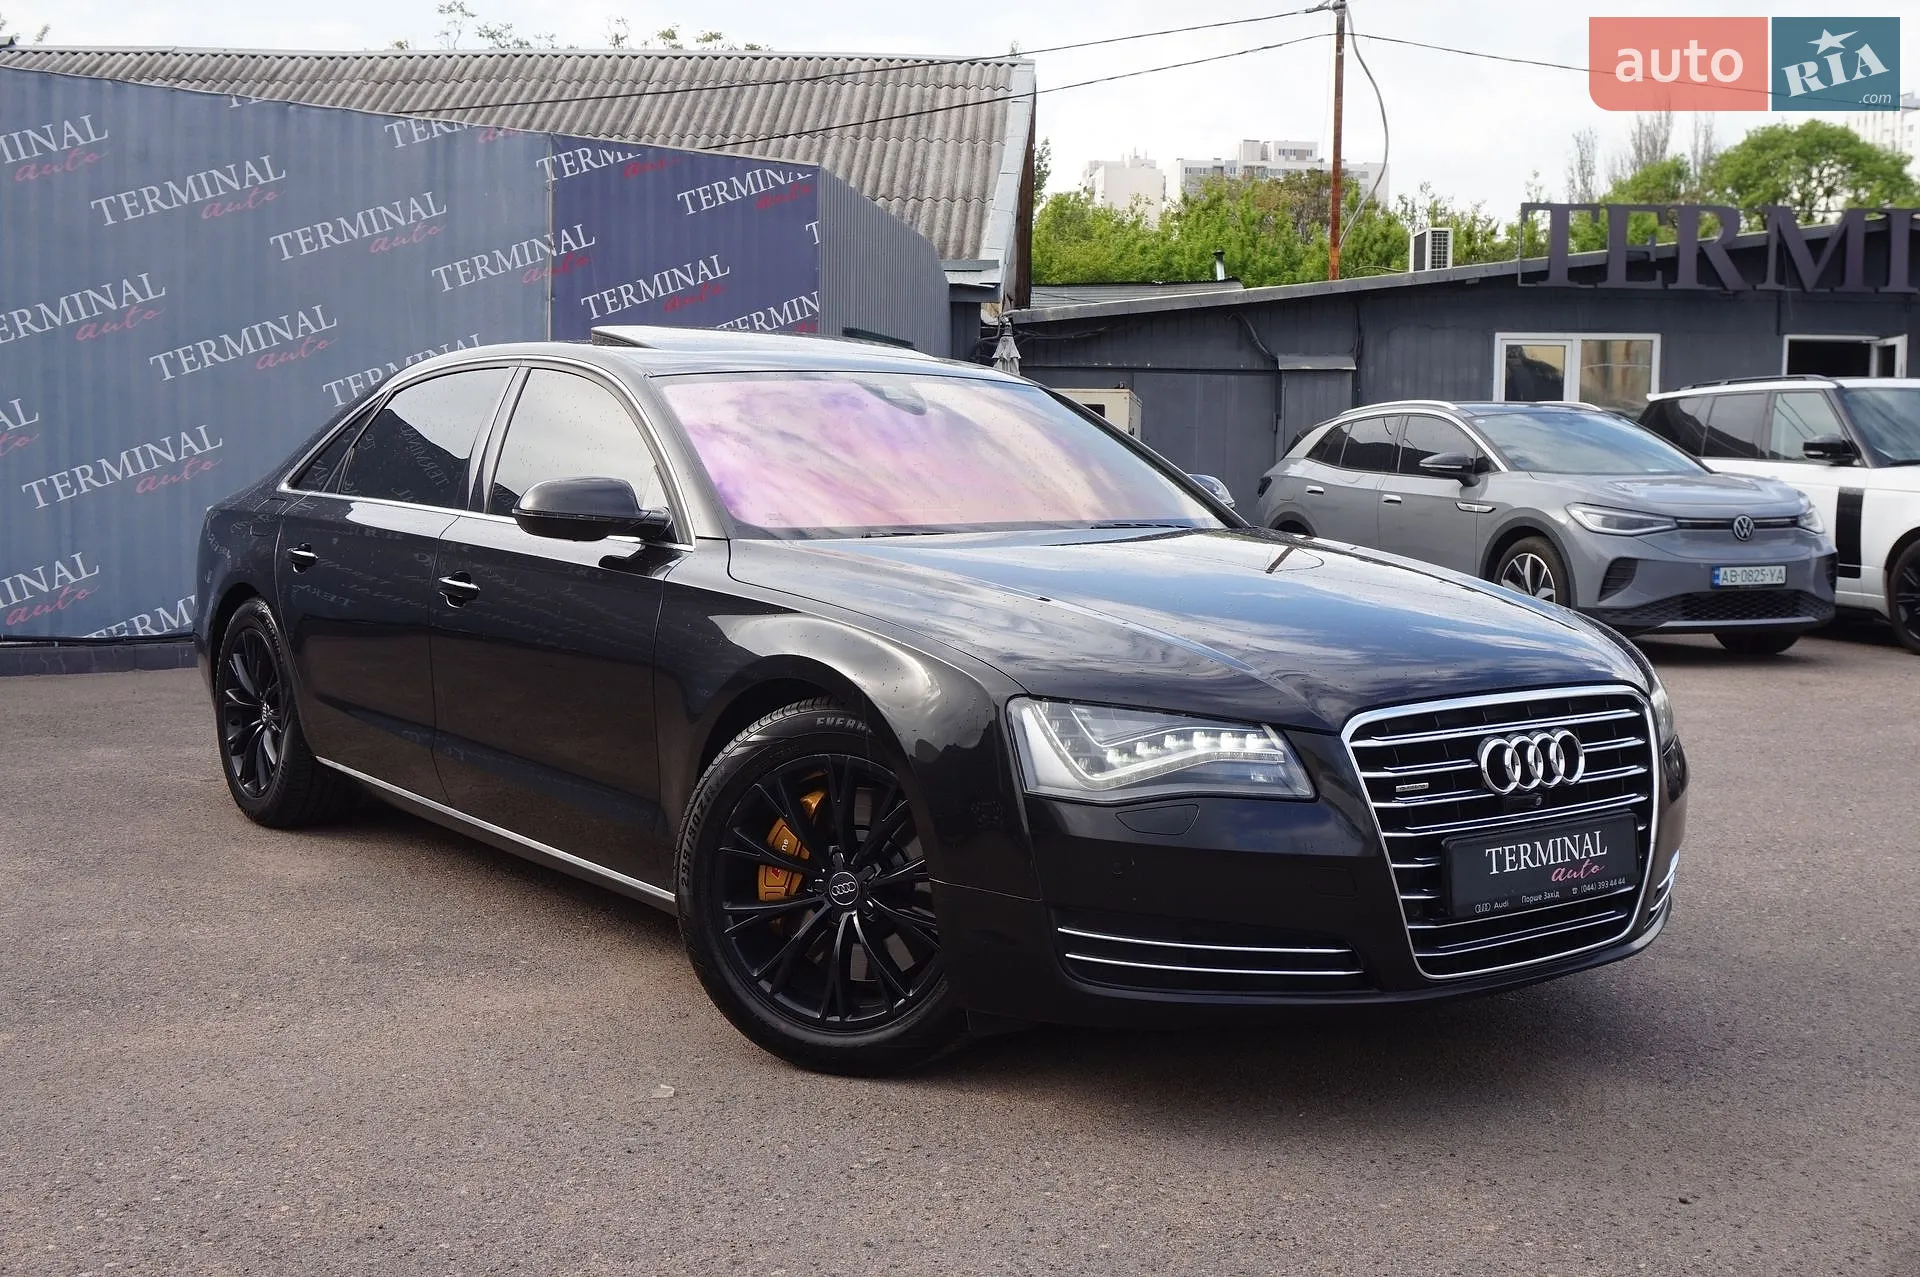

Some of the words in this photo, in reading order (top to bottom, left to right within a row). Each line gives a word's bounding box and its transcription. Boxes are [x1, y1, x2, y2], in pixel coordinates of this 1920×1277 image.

[13, 147, 108, 182] auto
[90, 154, 287, 226] TERMINAL
[200, 187, 286, 220] auto
[269, 191, 447, 262] TERMINAL
[369, 221, 446, 254] auto
[431, 223, 595, 293] TERMINAL
[522, 253, 591, 285] auto
[581, 254, 730, 321] TERMINAL
[75, 304, 166, 342] auto
[150, 304, 337, 382] TERMINAL
[255, 334, 337, 371] auto
[22, 424, 223, 510] TERMINAL
[135, 455, 222, 494] auto
[0, 551, 100, 618] INAL
[1721, 571, 1737, 583] AB
[1769, 568, 1784, 581] YA
[6, 585, 100, 626] auto
[1485, 831, 1608, 875] TERMINAL
[1551, 858, 1606, 882] auto
[1493, 900, 1509, 910] Audi
